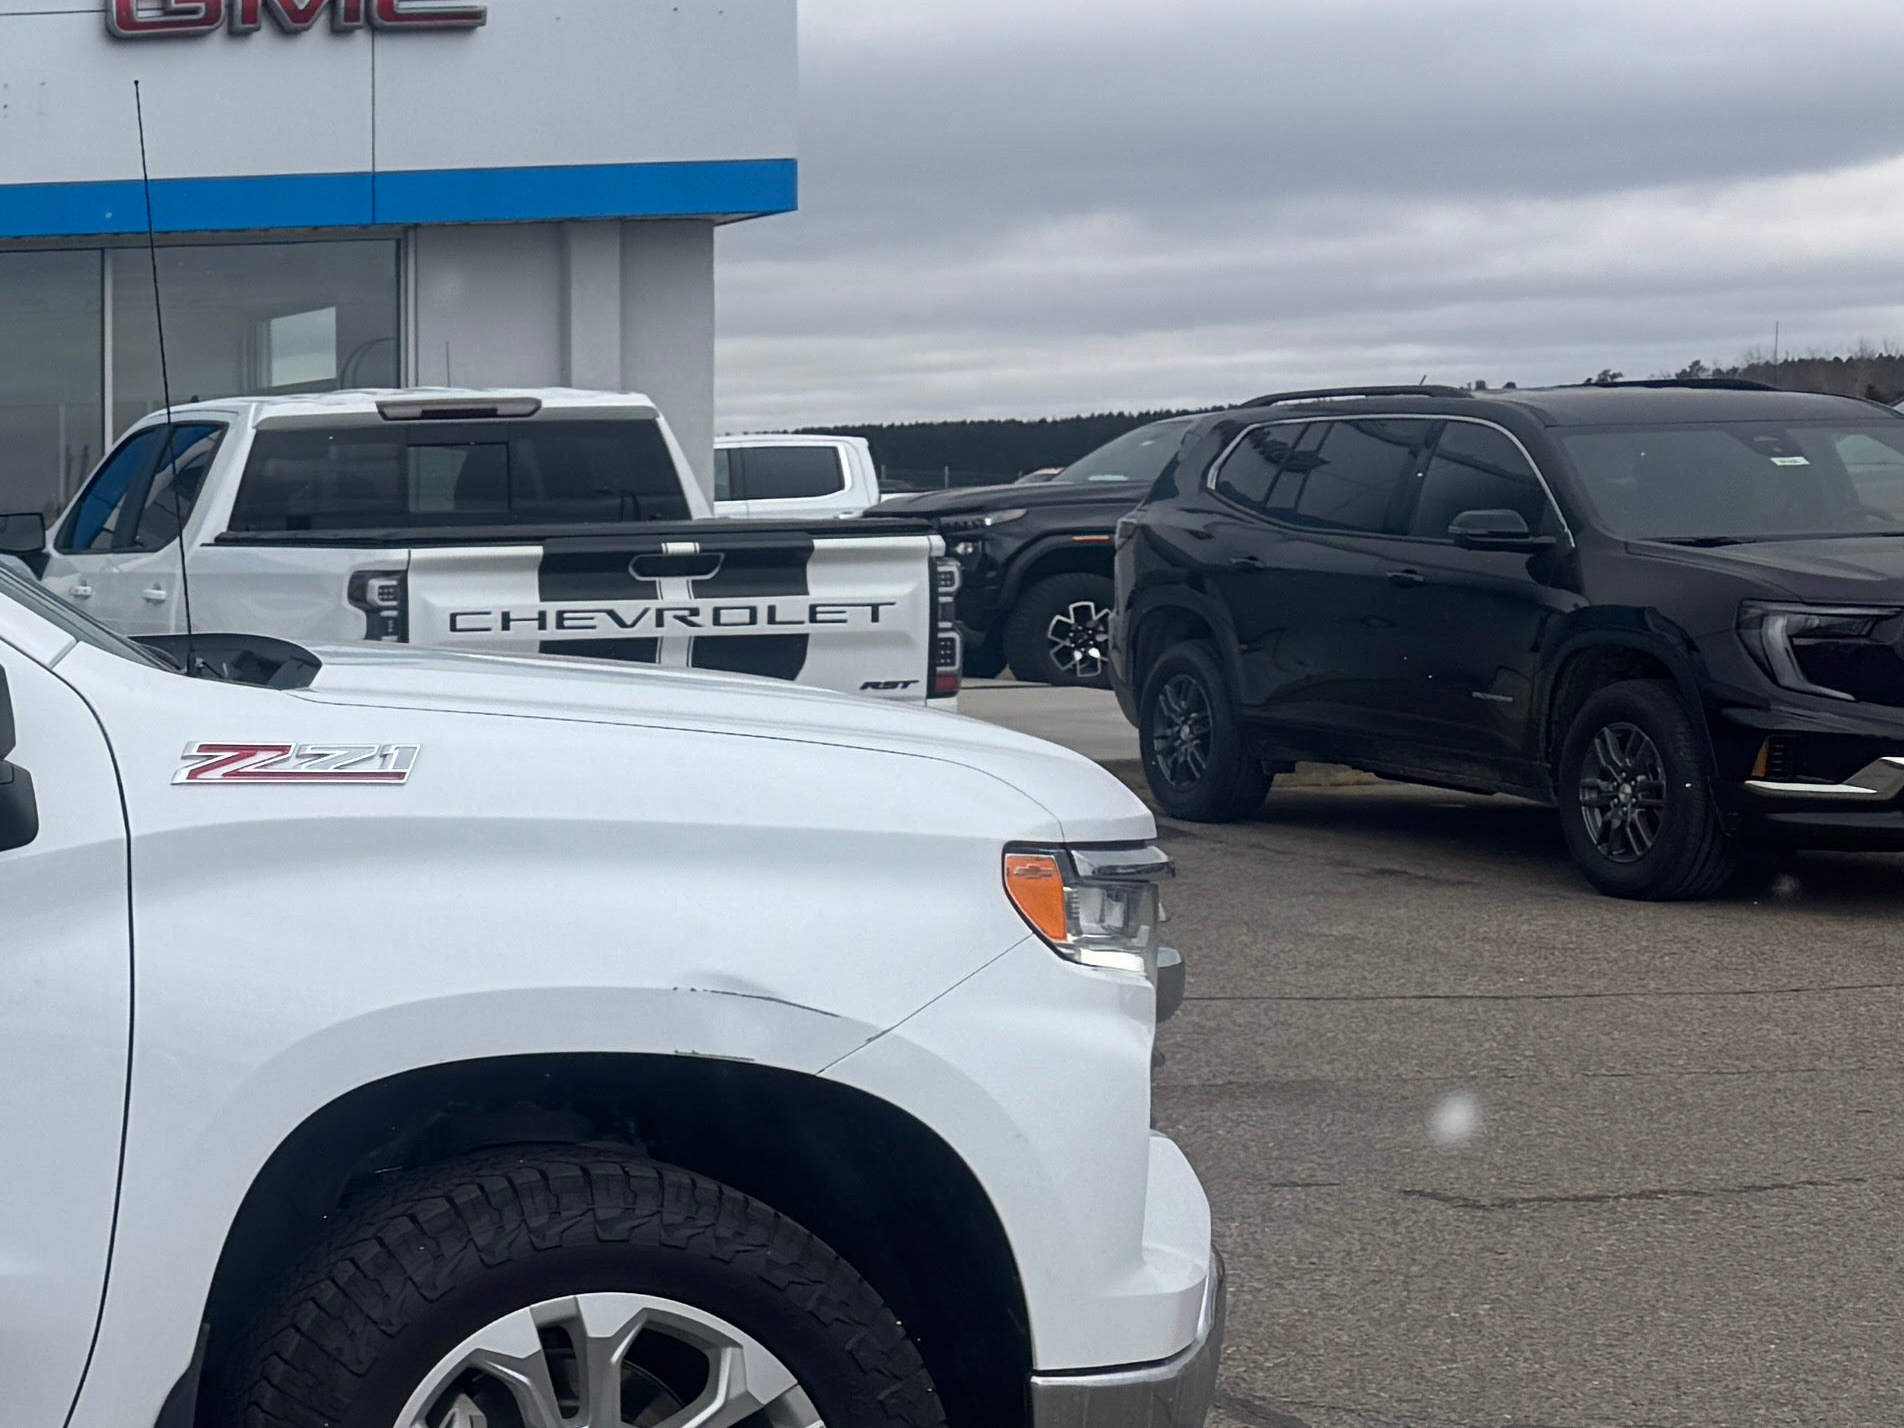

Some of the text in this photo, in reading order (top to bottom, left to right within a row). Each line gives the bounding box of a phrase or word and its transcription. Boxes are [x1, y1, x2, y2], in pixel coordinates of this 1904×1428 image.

[448, 601, 897, 633] CHEVROLET
[859, 679, 920, 691] RST
[170, 740, 422, 785] Z71
